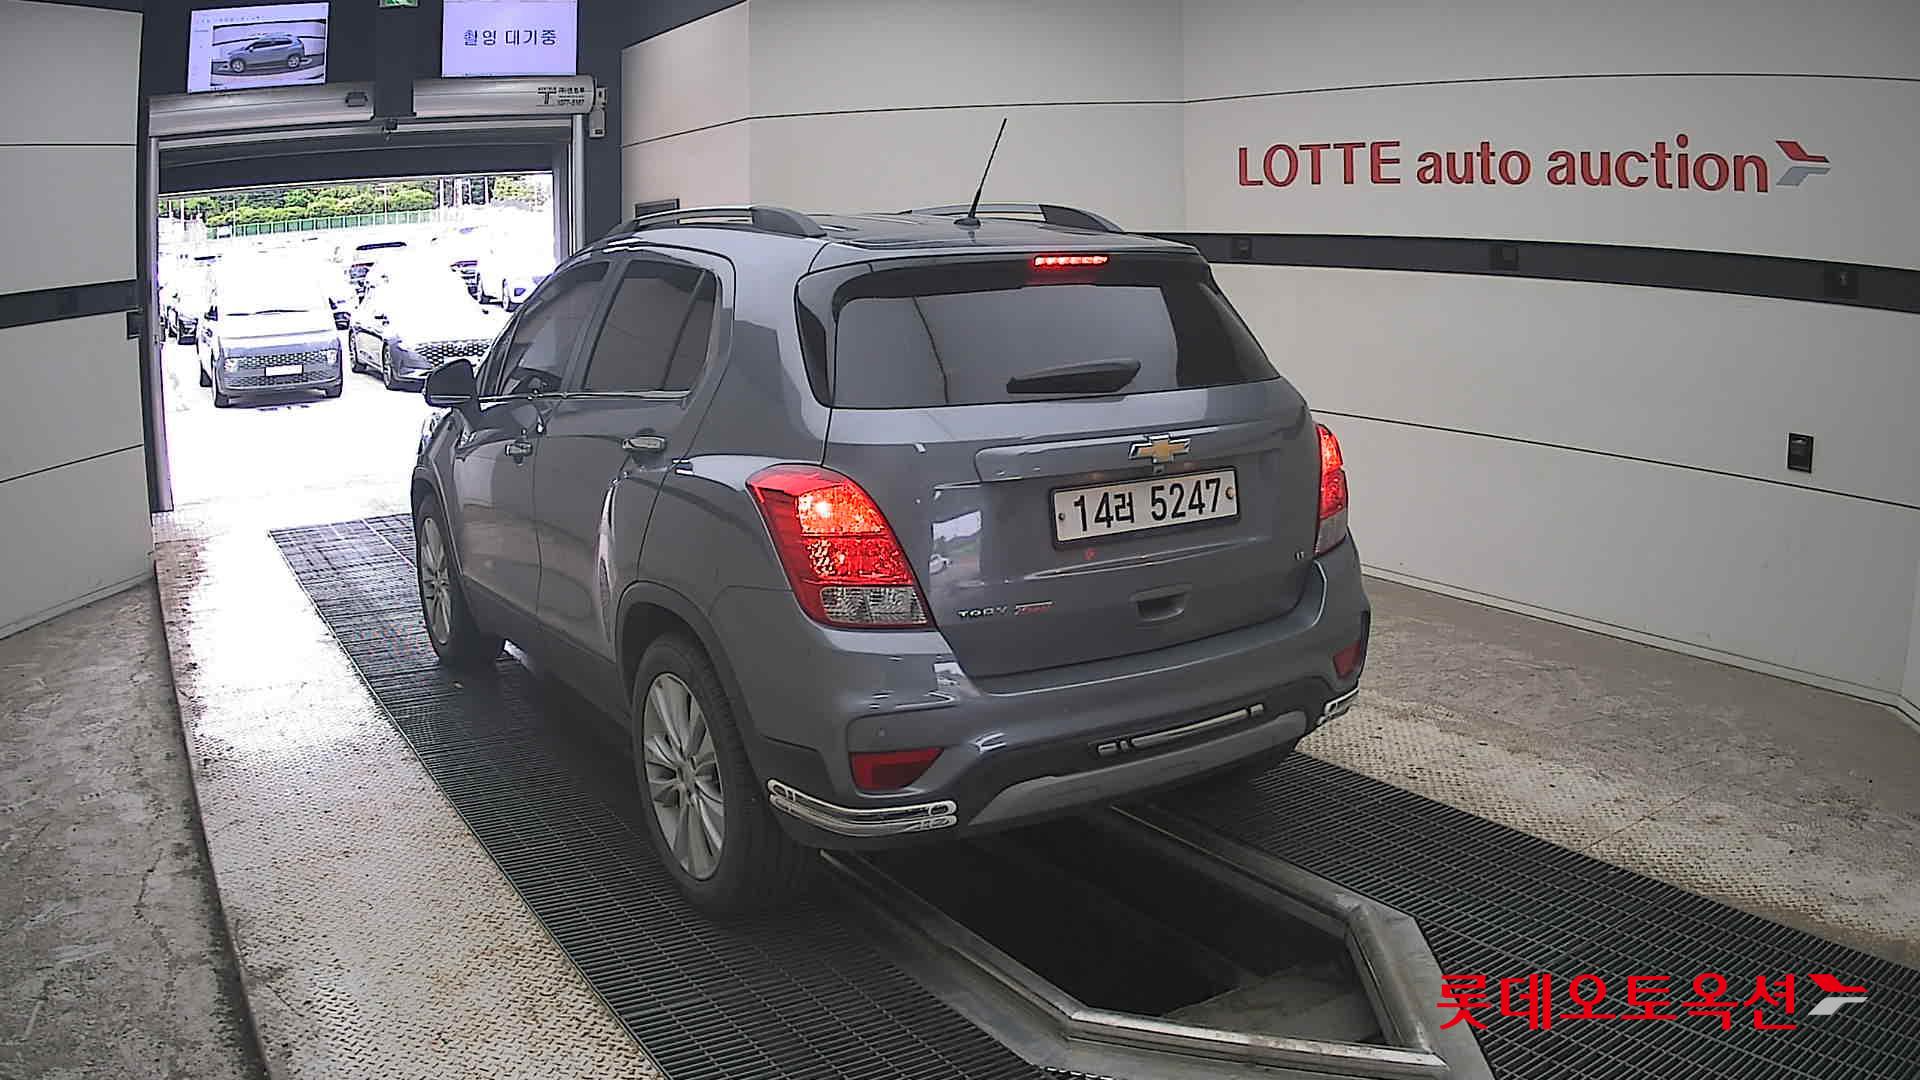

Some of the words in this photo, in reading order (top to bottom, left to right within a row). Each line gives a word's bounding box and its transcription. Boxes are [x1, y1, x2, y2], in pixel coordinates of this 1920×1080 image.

[505, 29, 557, 46] 대기중
[1238, 141, 1400, 188] LOTTE
[1416, 141, 1531, 187] auto
[1547, 134, 1769, 193] auction
[1073, 491, 1135, 532] 14러
[1151, 478, 1221, 522] 5247
